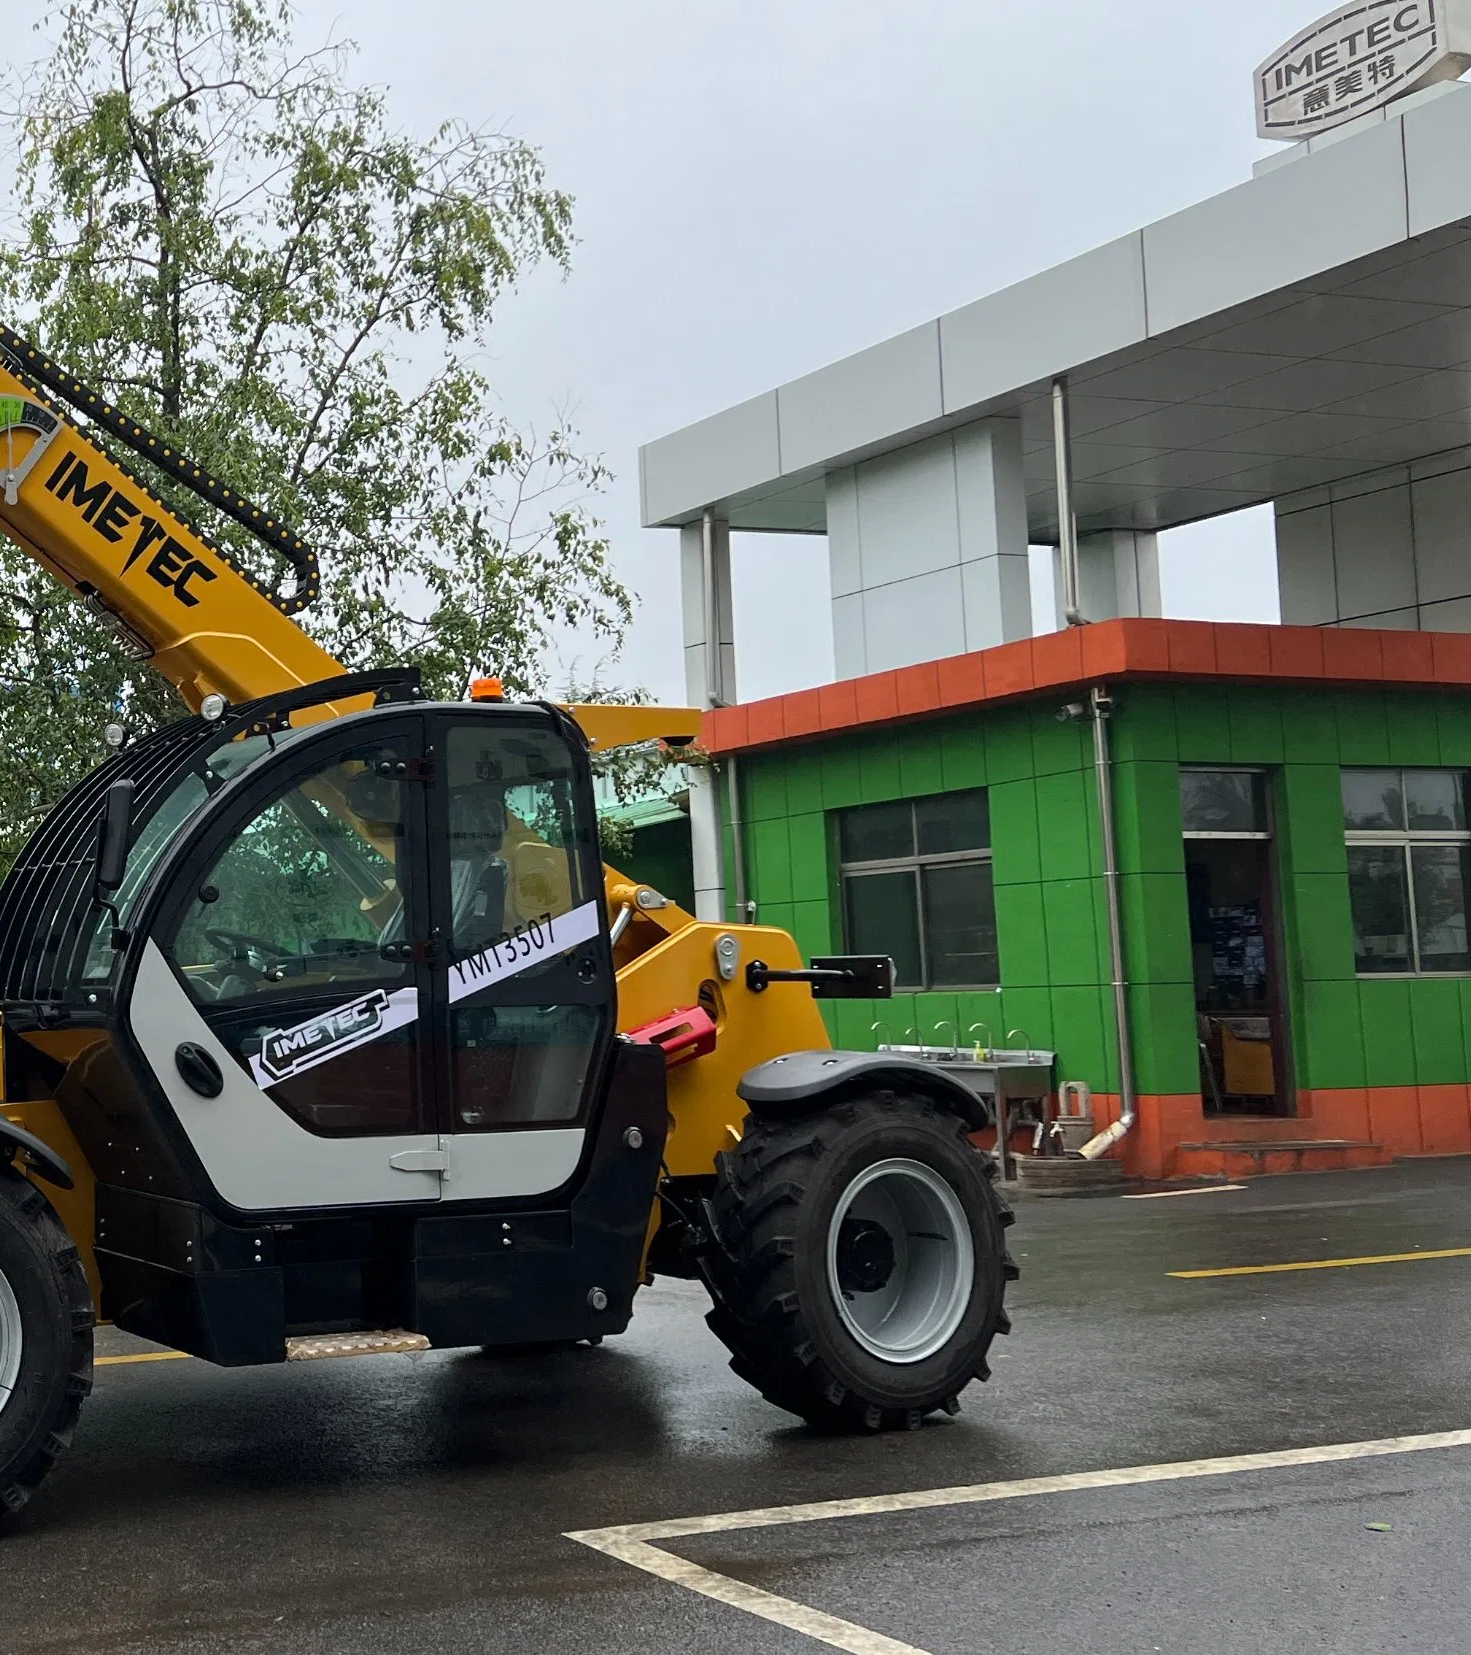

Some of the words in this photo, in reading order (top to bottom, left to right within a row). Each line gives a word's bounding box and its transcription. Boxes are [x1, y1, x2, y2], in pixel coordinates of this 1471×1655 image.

[1275, 4, 1419, 91] IMETEC
[1303, 55, 1395, 116] 意美特
[44, 450, 218, 608] IMETEC
[272, 1002, 371, 1058] IMETEC
